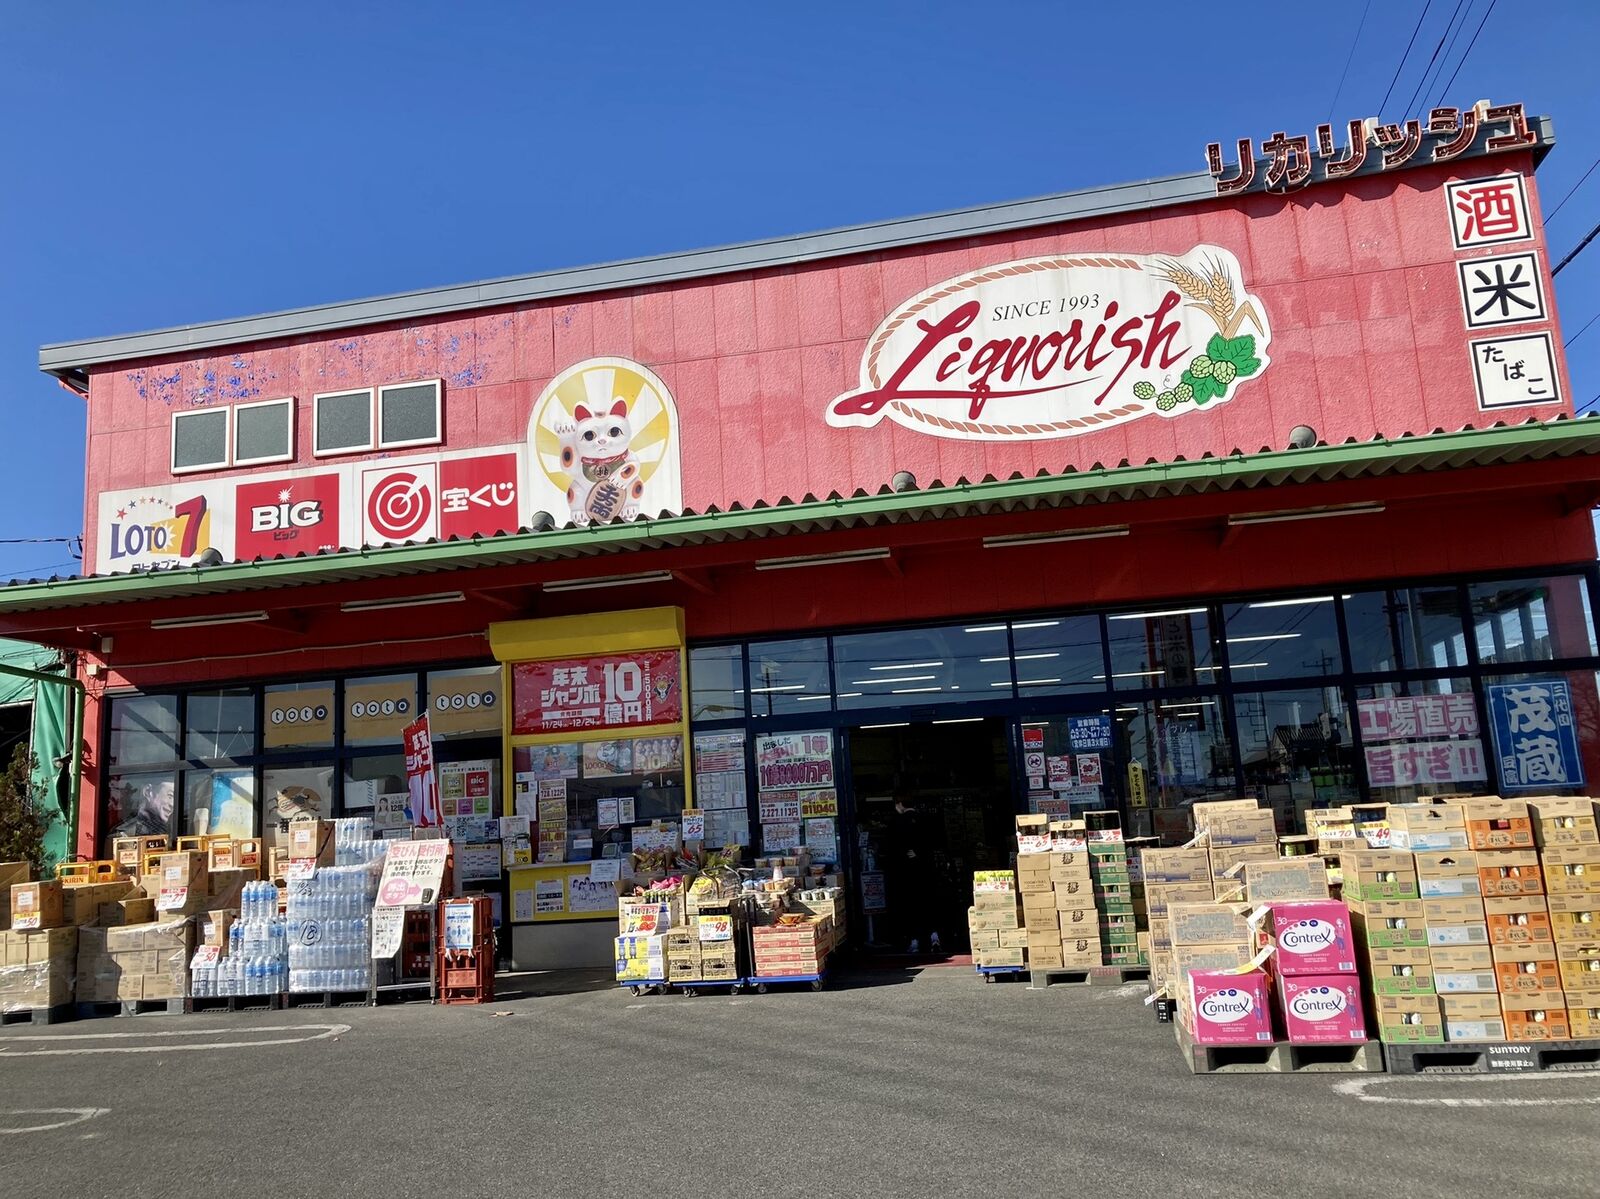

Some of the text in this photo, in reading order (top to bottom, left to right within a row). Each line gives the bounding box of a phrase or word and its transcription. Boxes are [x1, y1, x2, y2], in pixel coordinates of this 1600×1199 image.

[1205, 103, 1536, 197] リカリッシュ
[1456, 183, 1518, 241] 酒
[1472, 263, 1536, 317] 米
[992, 293, 1101, 322] SINCE 1993
[833, 290, 1193, 420] Liquorish
[1482, 345, 1547, 395] たばこ
[441, 481, 516, 513] 宝くじ
[110, 494, 208, 560] LOTO 7
[250, 500, 323, 533] BIG
[552, 666, 588, 686] 年末
[603, 662, 642, 703] 10
[435, 690, 496, 711] toto
[541, 682, 600, 707] ジャンボ
[271, 705, 329, 725] toto
[351, 697, 410, 718] toto
[604, 702, 643, 724] 億円
[1359, 696, 1478, 736] 工場直売
[1505, 685, 1567, 784] 茂蔵
[1367, 743, 1479, 784] 旨すぎ!!
[688, 824, 702, 834] 65
[1338, 829, 1352, 838] 70
[1376, 827, 1390, 839] 49
[26, 917, 38, 927] 50
[301, 925, 317, 939] 18
[714, 921, 729, 933] 98
[1283, 926, 1335, 948] Contrex
[1202, 997, 1251, 1017] Contrex
[1293, 994, 1345, 1015] Contrex
